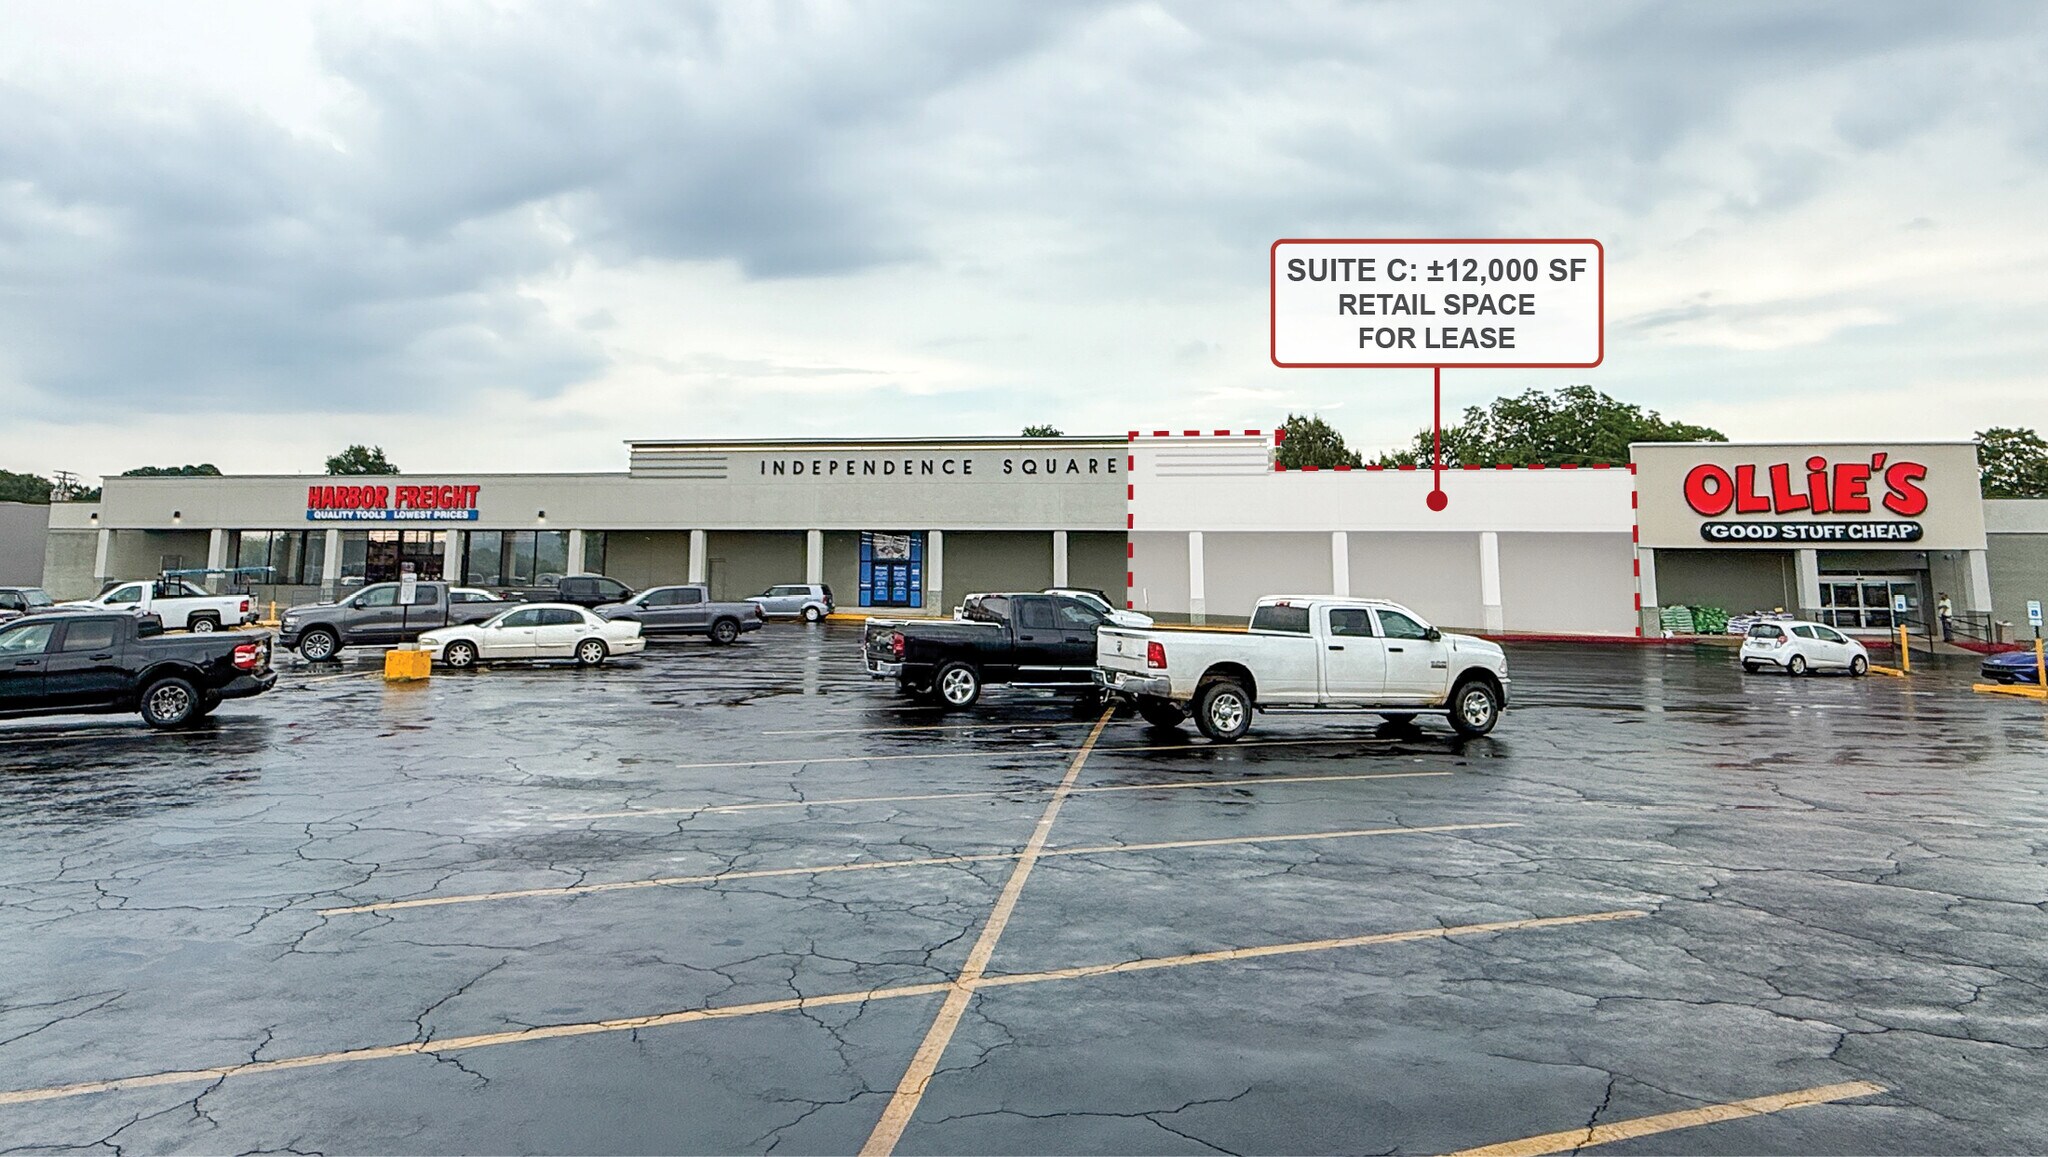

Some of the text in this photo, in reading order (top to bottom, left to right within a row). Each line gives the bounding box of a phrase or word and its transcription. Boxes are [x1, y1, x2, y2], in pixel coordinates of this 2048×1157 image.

[760, 458, 1117, 476] INDEPENDENCE SQUARE
[307, 485, 481, 509] HARBOR FREIGHT
[313, 510, 469, 520] QUALITY TOOLS LOWEST PRICES
[1782, 524, 1847, 539] STUFF
